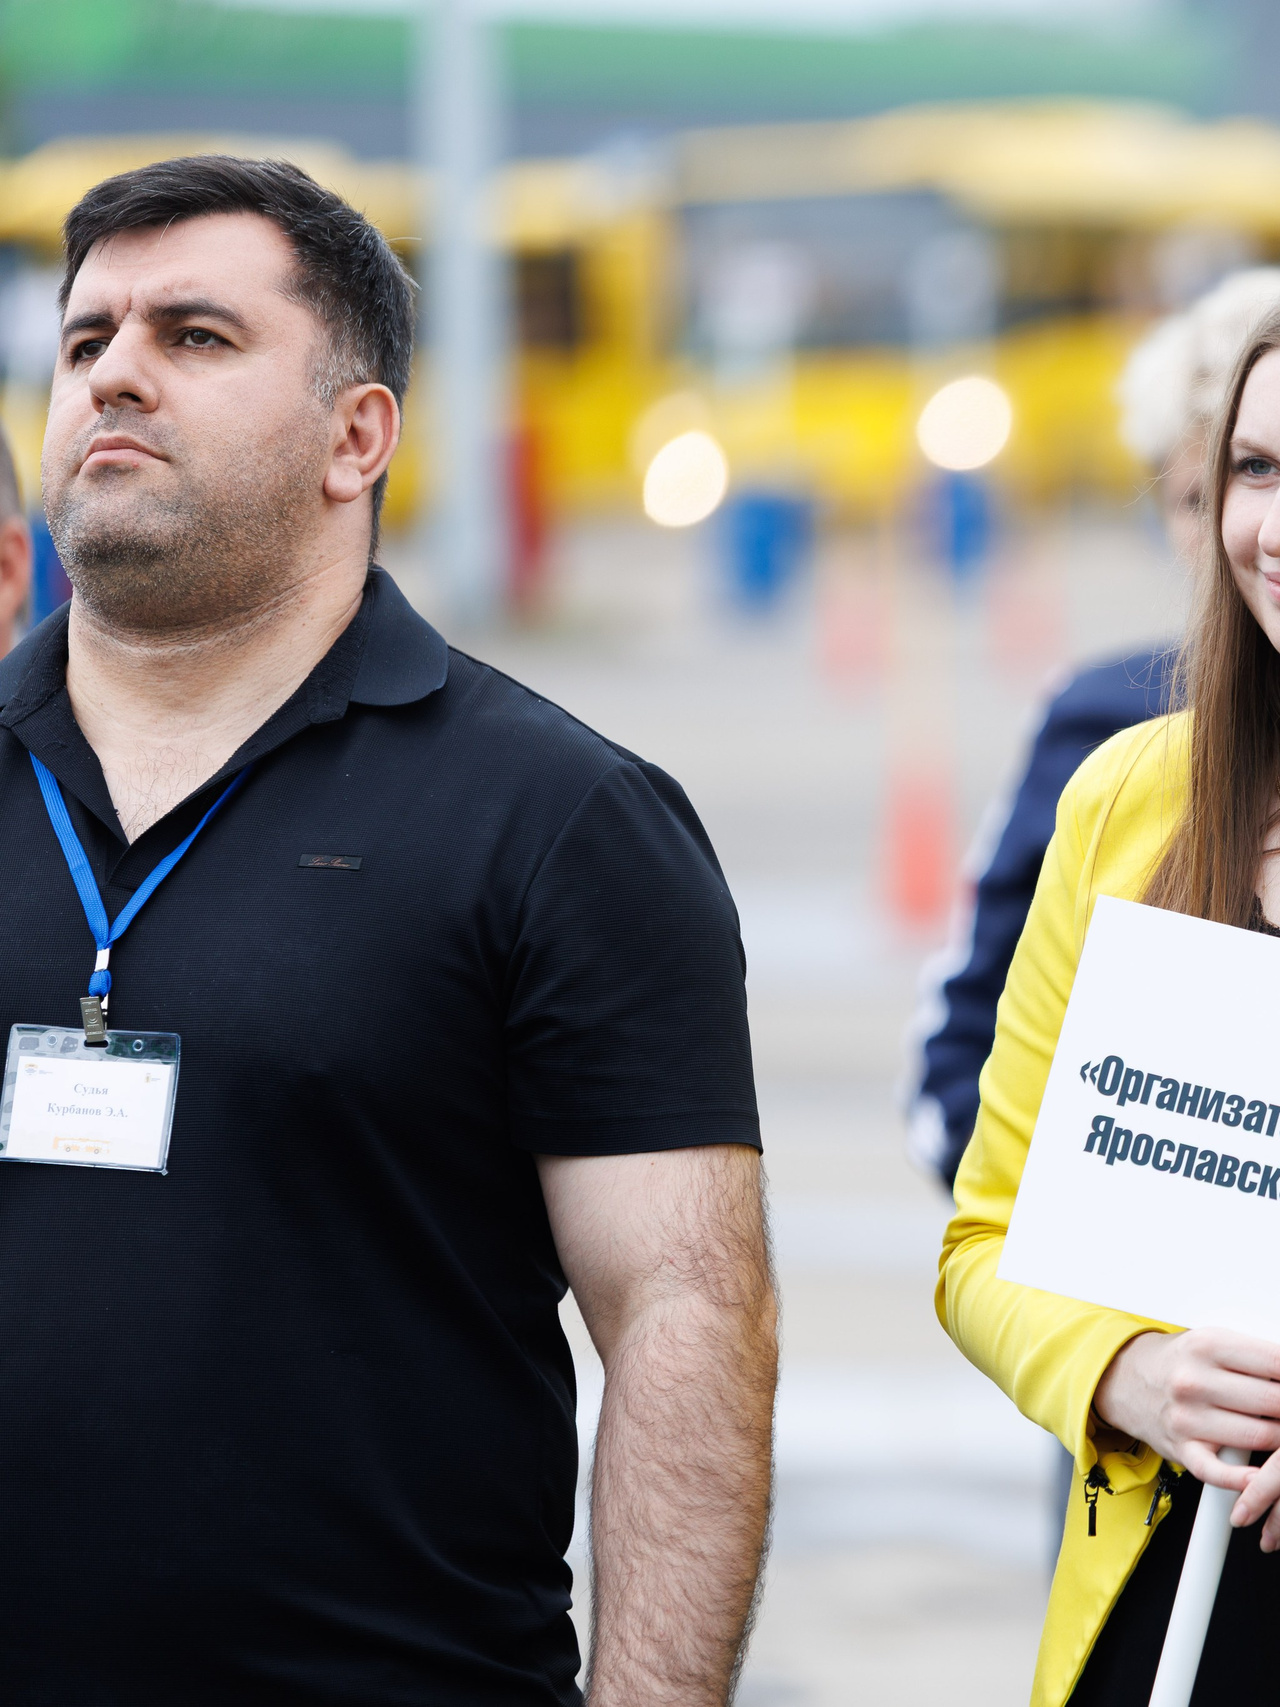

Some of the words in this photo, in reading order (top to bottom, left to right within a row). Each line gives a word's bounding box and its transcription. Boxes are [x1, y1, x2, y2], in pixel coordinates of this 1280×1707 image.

[73, 1083, 109, 1096] Судья
[47, 1102, 102, 1117] Курбанов
[105, 1106, 128, 1118] Э.А.
